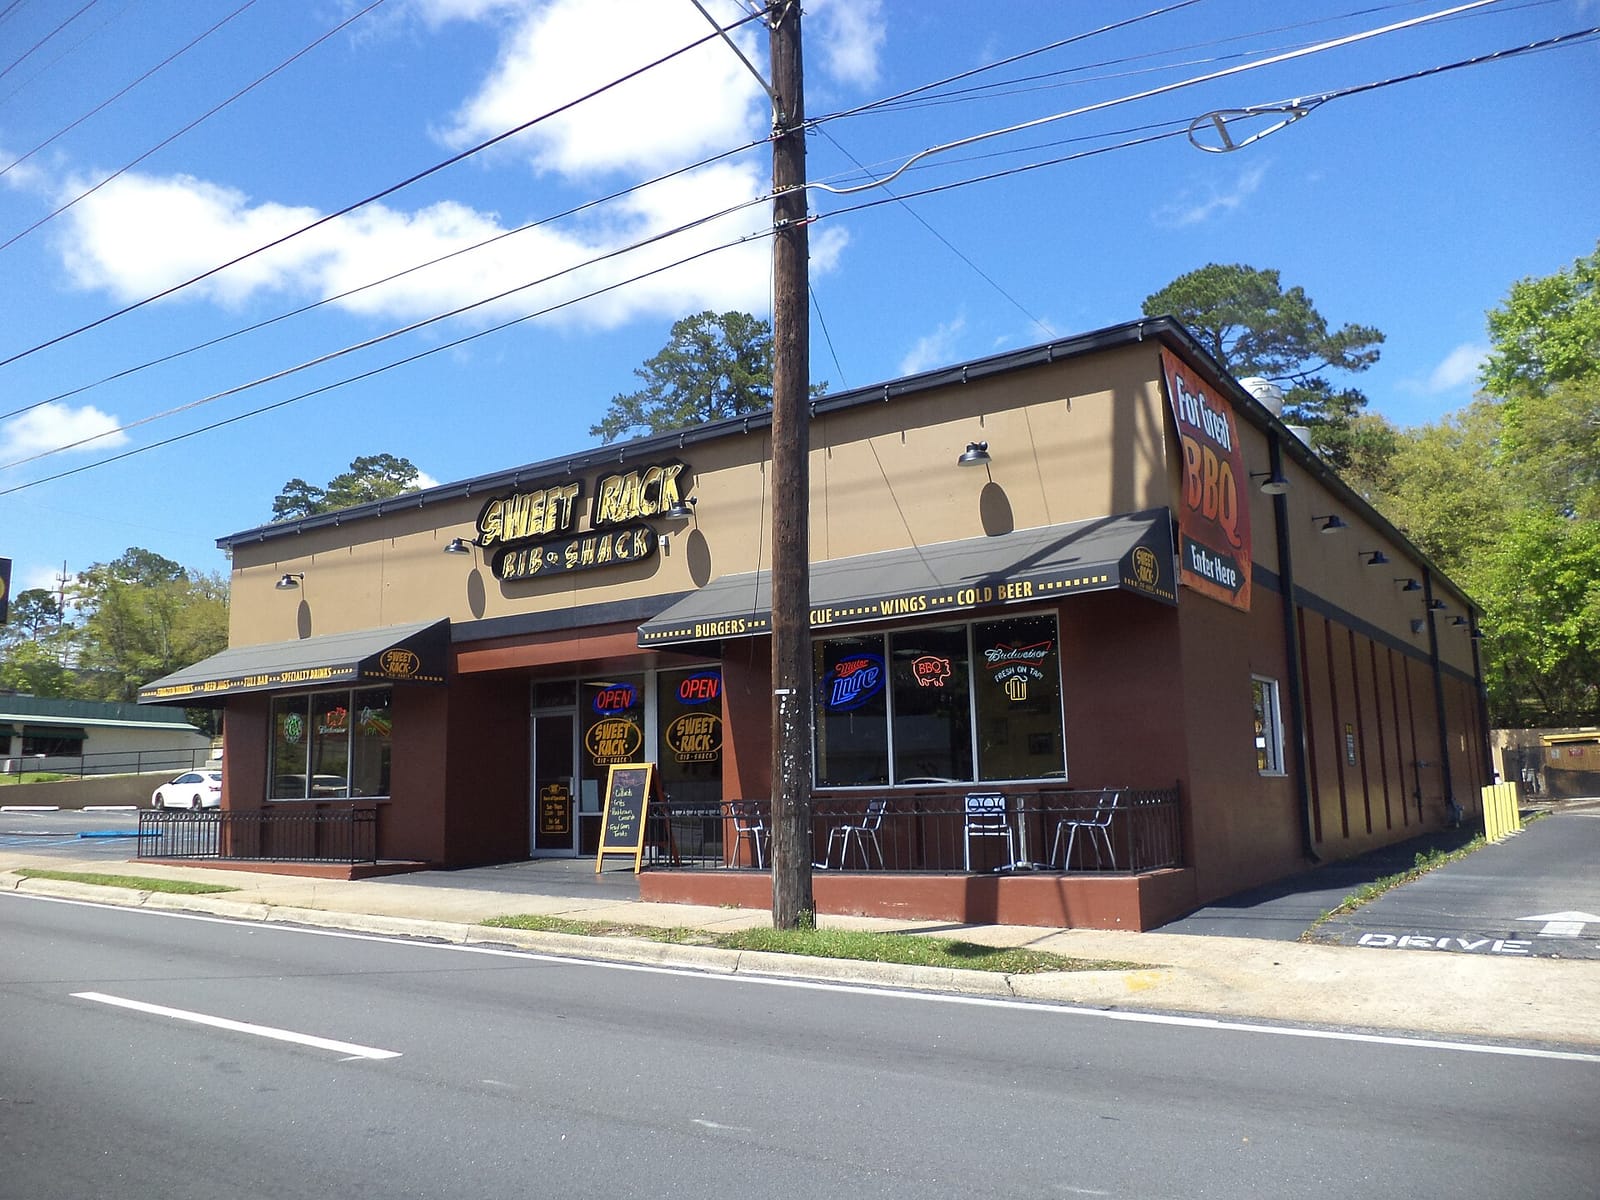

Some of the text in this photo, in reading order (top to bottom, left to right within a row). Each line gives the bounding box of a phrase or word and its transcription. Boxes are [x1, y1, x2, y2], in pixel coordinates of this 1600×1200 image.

[1175, 375, 1232, 453] For Great
[1182, 434, 1242, 549] BBQ
[480, 463, 684, 546] SWEET RACK
[502, 528, 650, 579] RIB SHACK
[1190, 544, 1237, 588] Enter Here
[695, 618, 746, 639] BURGERS
[880, 595, 927, 617] WINGS
[957, 587, 993, 607] COLD
[998, 581, 1034, 601] BEER
[386, 651, 414, 663] SWEET
[983, 648, 1049, 662] Budweiser
[243, 676, 257, 688] FULL
[256, 674, 269, 686] BAR
[280, 669, 310, 683] SPECIALTY
[309, 667, 332, 680] DRINKS
[834, 659, 870, 678] Miller
[918, 660, 942, 675] BBQ
[994, 665, 1044, 683] FRESH ON TAP
[680, 678, 719, 699] OPEN
[596, 690, 632, 709] OPEN
[594, 722, 632, 741] SWEET
[676, 717, 717, 737] SWEET
[598, 739, 626, 757] RACK
[680, 734, 711, 752] RACK
[1357, 932, 1533, 954] DRIVE
